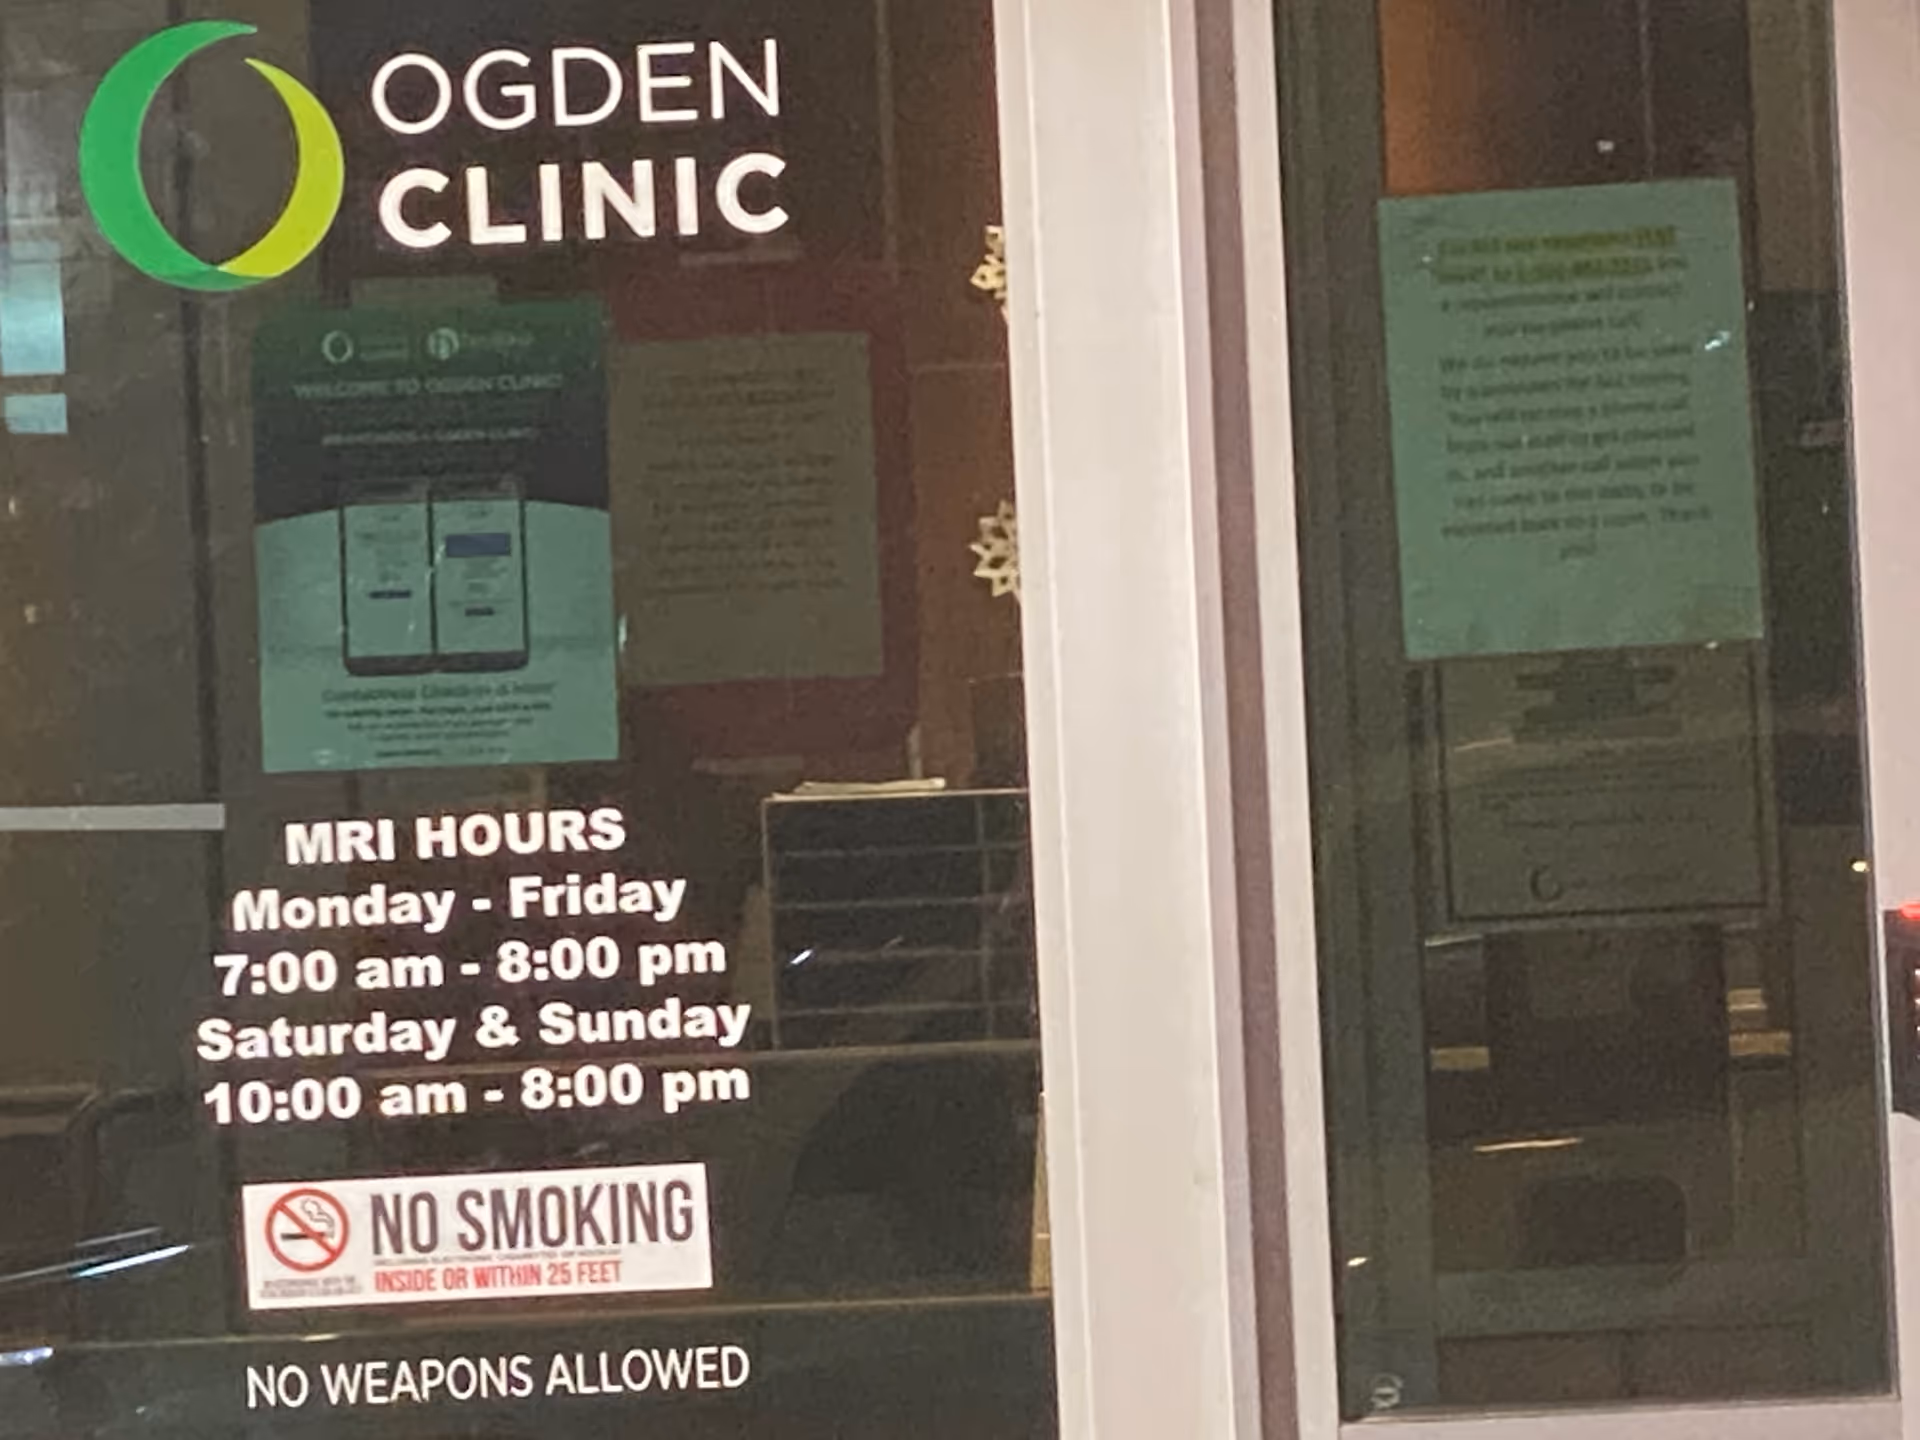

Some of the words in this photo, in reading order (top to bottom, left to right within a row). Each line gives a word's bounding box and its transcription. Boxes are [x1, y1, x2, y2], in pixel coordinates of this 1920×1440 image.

[371, 38, 780, 135] OGDEN
[378, 152, 790, 249] CLINIC
[284, 819, 396, 866] MRI
[416, 808, 626, 860] HOURS
[232, 883, 457, 934] Monday
[472, 898, 492, 911] -
[509, 873, 687, 922] Friday
[213, 950, 337, 996] 7:00
[356, 955, 444, 990] am
[460, 963, 482, 975] -
[498, 936, 620, 983] 8:00
[639, 940, 727, 987] pm
[197, 1011, 457, 1062] Saturday
[475, 1005, 520, 1049] &
[539, 996, 752, 1047] Sunday
[204, 1077, 362, 1125] 10:00
[379, 1081, 468, 1117] am
[484, 1089, 504, 1102] -
[521, 1063, 644, 1110] 8:00
[662, 1067, 751, 1114] pm
[371, 1191, 438, 1255] NO
[457, 1179, 694, 1251] SMOKING
[375, 1268, 437, 1293] INSIDE
[443, 1267, 469, 1291] OR
[474, 1264, 542, 1289] WITHIN
[547, 1262, 572, 1287] 25
[577, 1260, 623, 1284] FEET
[247, 1364, 310, 1409] NO
[320, 1355, 534, 1406] WEAPONS
[545, 1345, 751, 1396] ALLOWED
